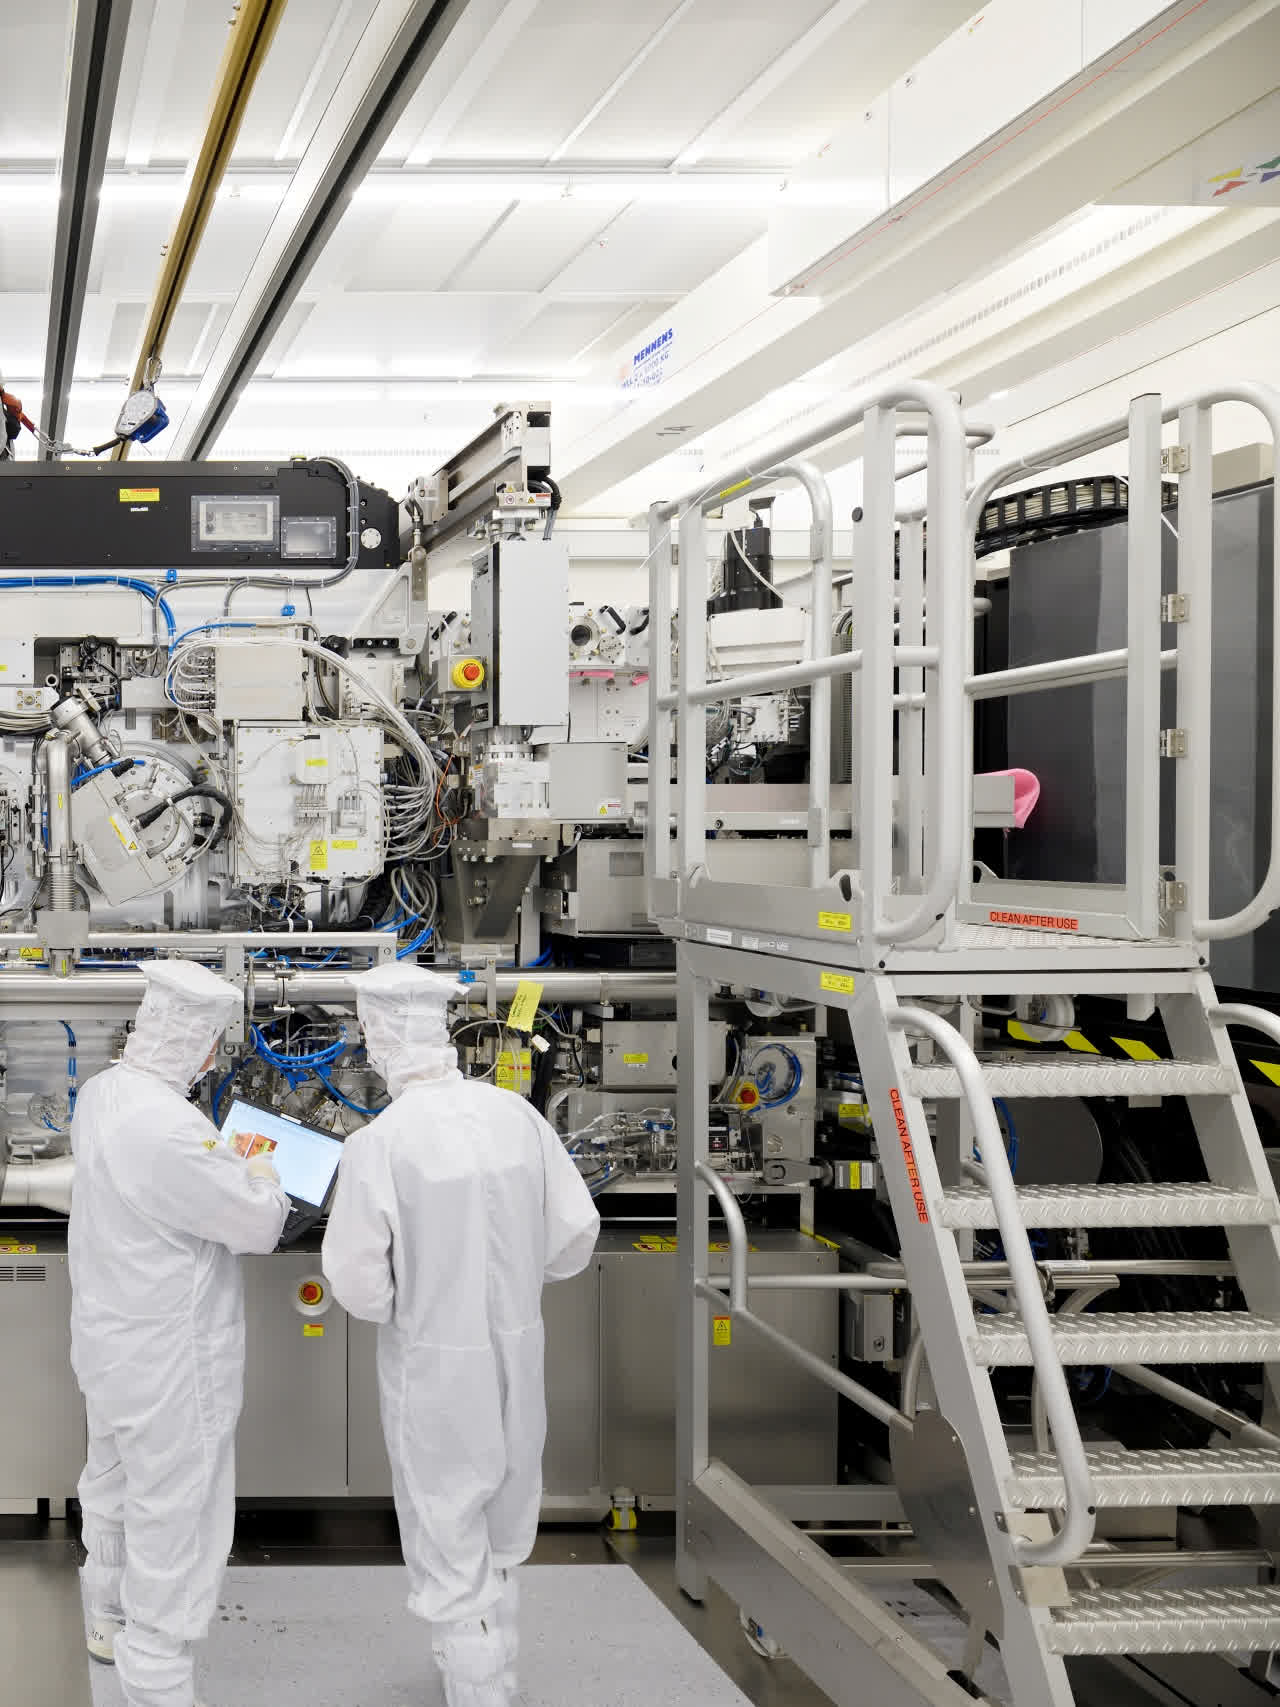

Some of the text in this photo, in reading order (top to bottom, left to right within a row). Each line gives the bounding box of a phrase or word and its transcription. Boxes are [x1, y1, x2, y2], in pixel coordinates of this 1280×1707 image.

[633, 328, 673, 366] MENNENS
[989, 911, 1078, 930] CLEAN AFTER USE
[890, 1089, 929, 1223] CLEAN AFTER USE
